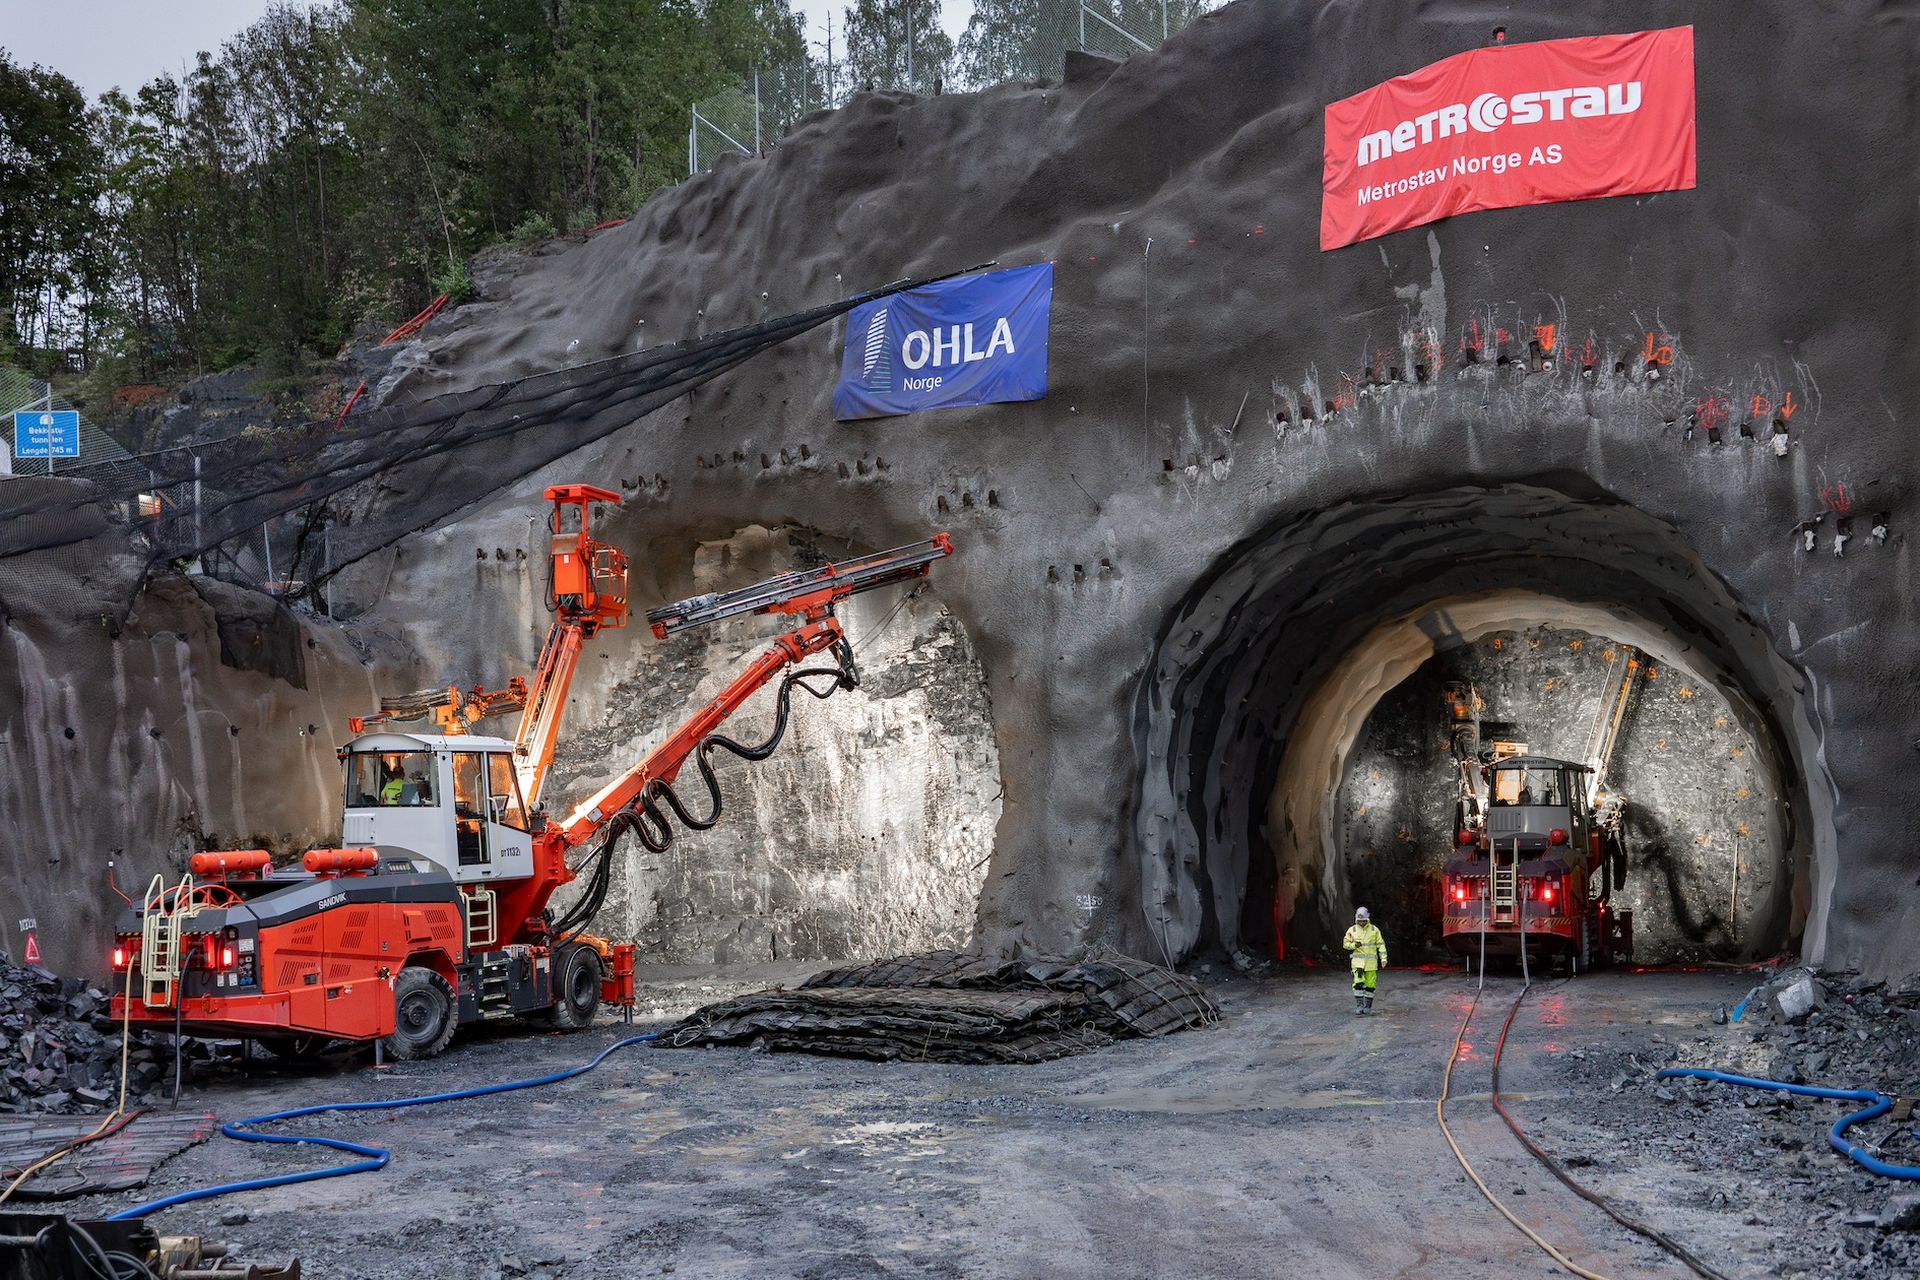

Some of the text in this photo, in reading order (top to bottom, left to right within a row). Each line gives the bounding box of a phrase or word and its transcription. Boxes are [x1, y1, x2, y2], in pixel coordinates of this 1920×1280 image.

[1357, 144, 1563, 206] Metrostav Norge AS
[902, 317, 1015, 370] OHLA
[903, 376, 942, 392] Norge
[22, 447, 48, 455] Lengde
[318, 892, 347, 910] SANDVIK
